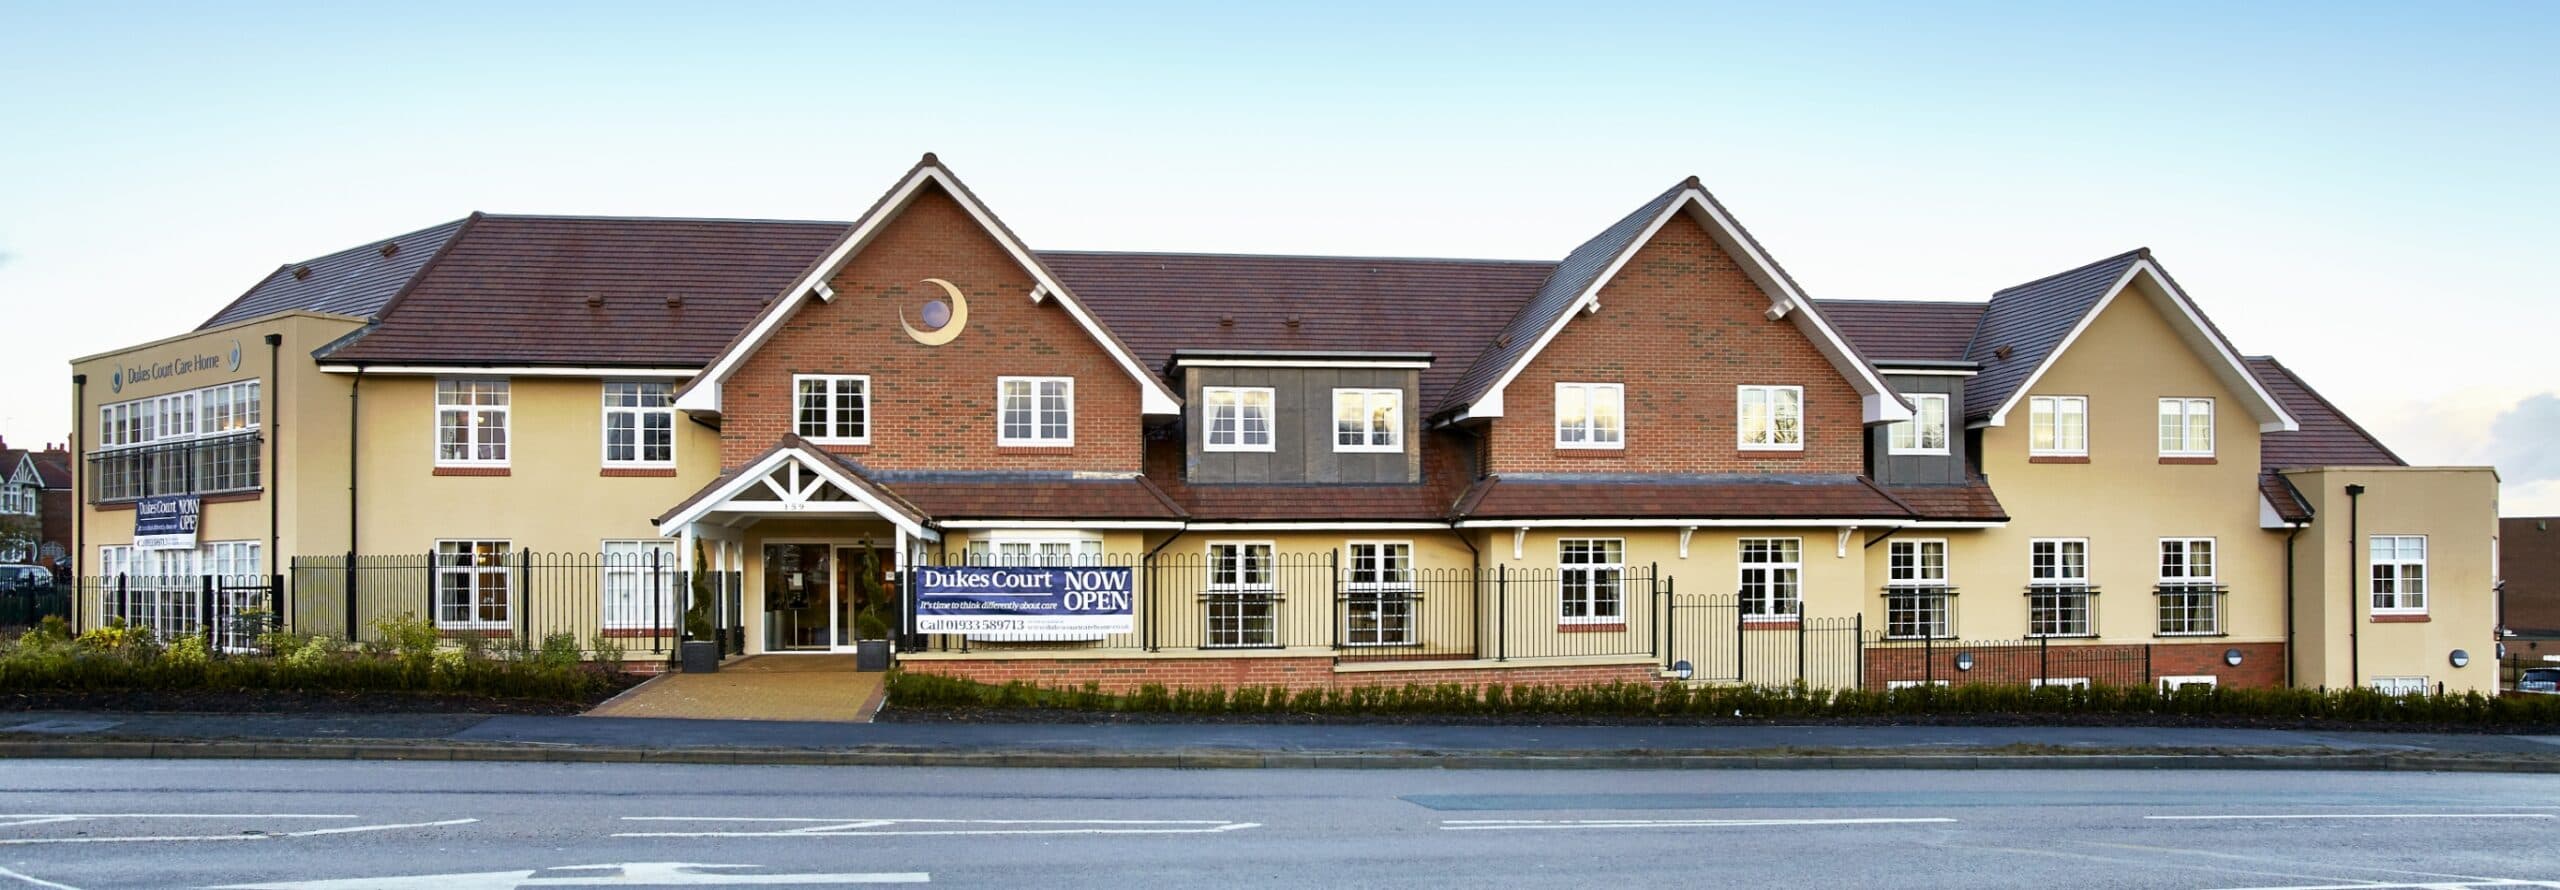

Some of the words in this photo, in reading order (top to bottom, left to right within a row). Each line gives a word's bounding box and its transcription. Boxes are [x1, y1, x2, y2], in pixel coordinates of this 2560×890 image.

[128, 367, 150, 384] Dukes
[152, 363, 174, 380] Court
[175, 358, 192, 376] Care
[194, 354, 220, 371] Home
[179, 498, 200, 514] NOW
[784, 503, 805, 511] 159
[924, 570, 989, 588] Dukes
[992, 570, 1053, 588] Court
[1064, 571, 1128, 590] NOW
[920, 601, 932, 610] It's
[932, 601, 951, 610] time
[951, 601, 959, 610] to
[960, 601, 981, 610] think
[981, 601, 1019, 611] differently
[1020, 601, 1040, 610] about
[1063, 591, 1129, 611] OPEN
[920, 619, 944, 631] Call
[946, 619, 980, 631] 01933
[982, 619, 1025, 631] 589713
